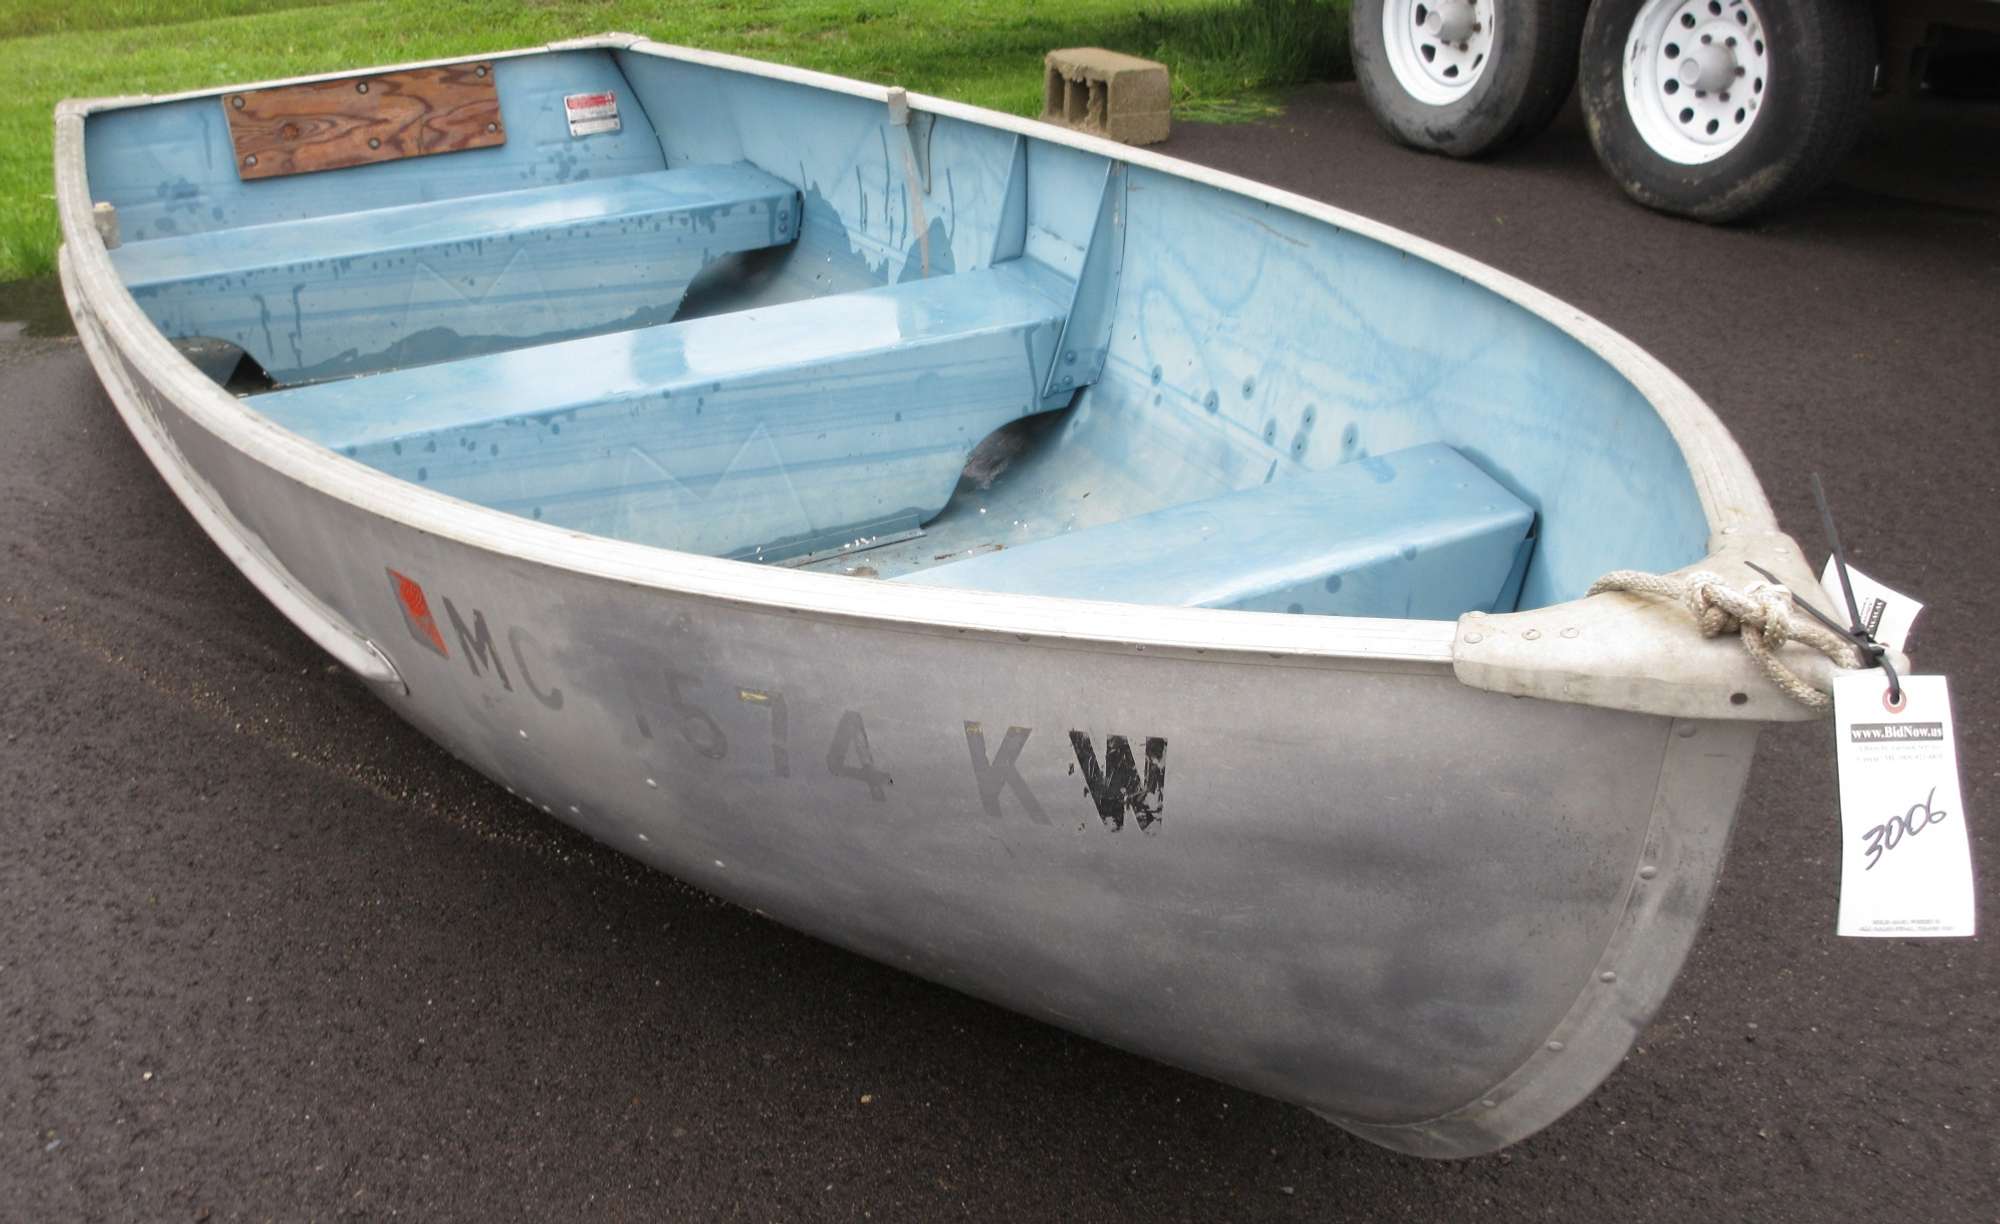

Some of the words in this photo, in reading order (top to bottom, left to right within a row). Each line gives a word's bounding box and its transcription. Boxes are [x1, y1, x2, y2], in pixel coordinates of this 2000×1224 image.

[442, 595, 564, 711] MC
[1851, 725, 1943, 739] www.BidNow.us
[1861, 786, 1947, 871] 3006
